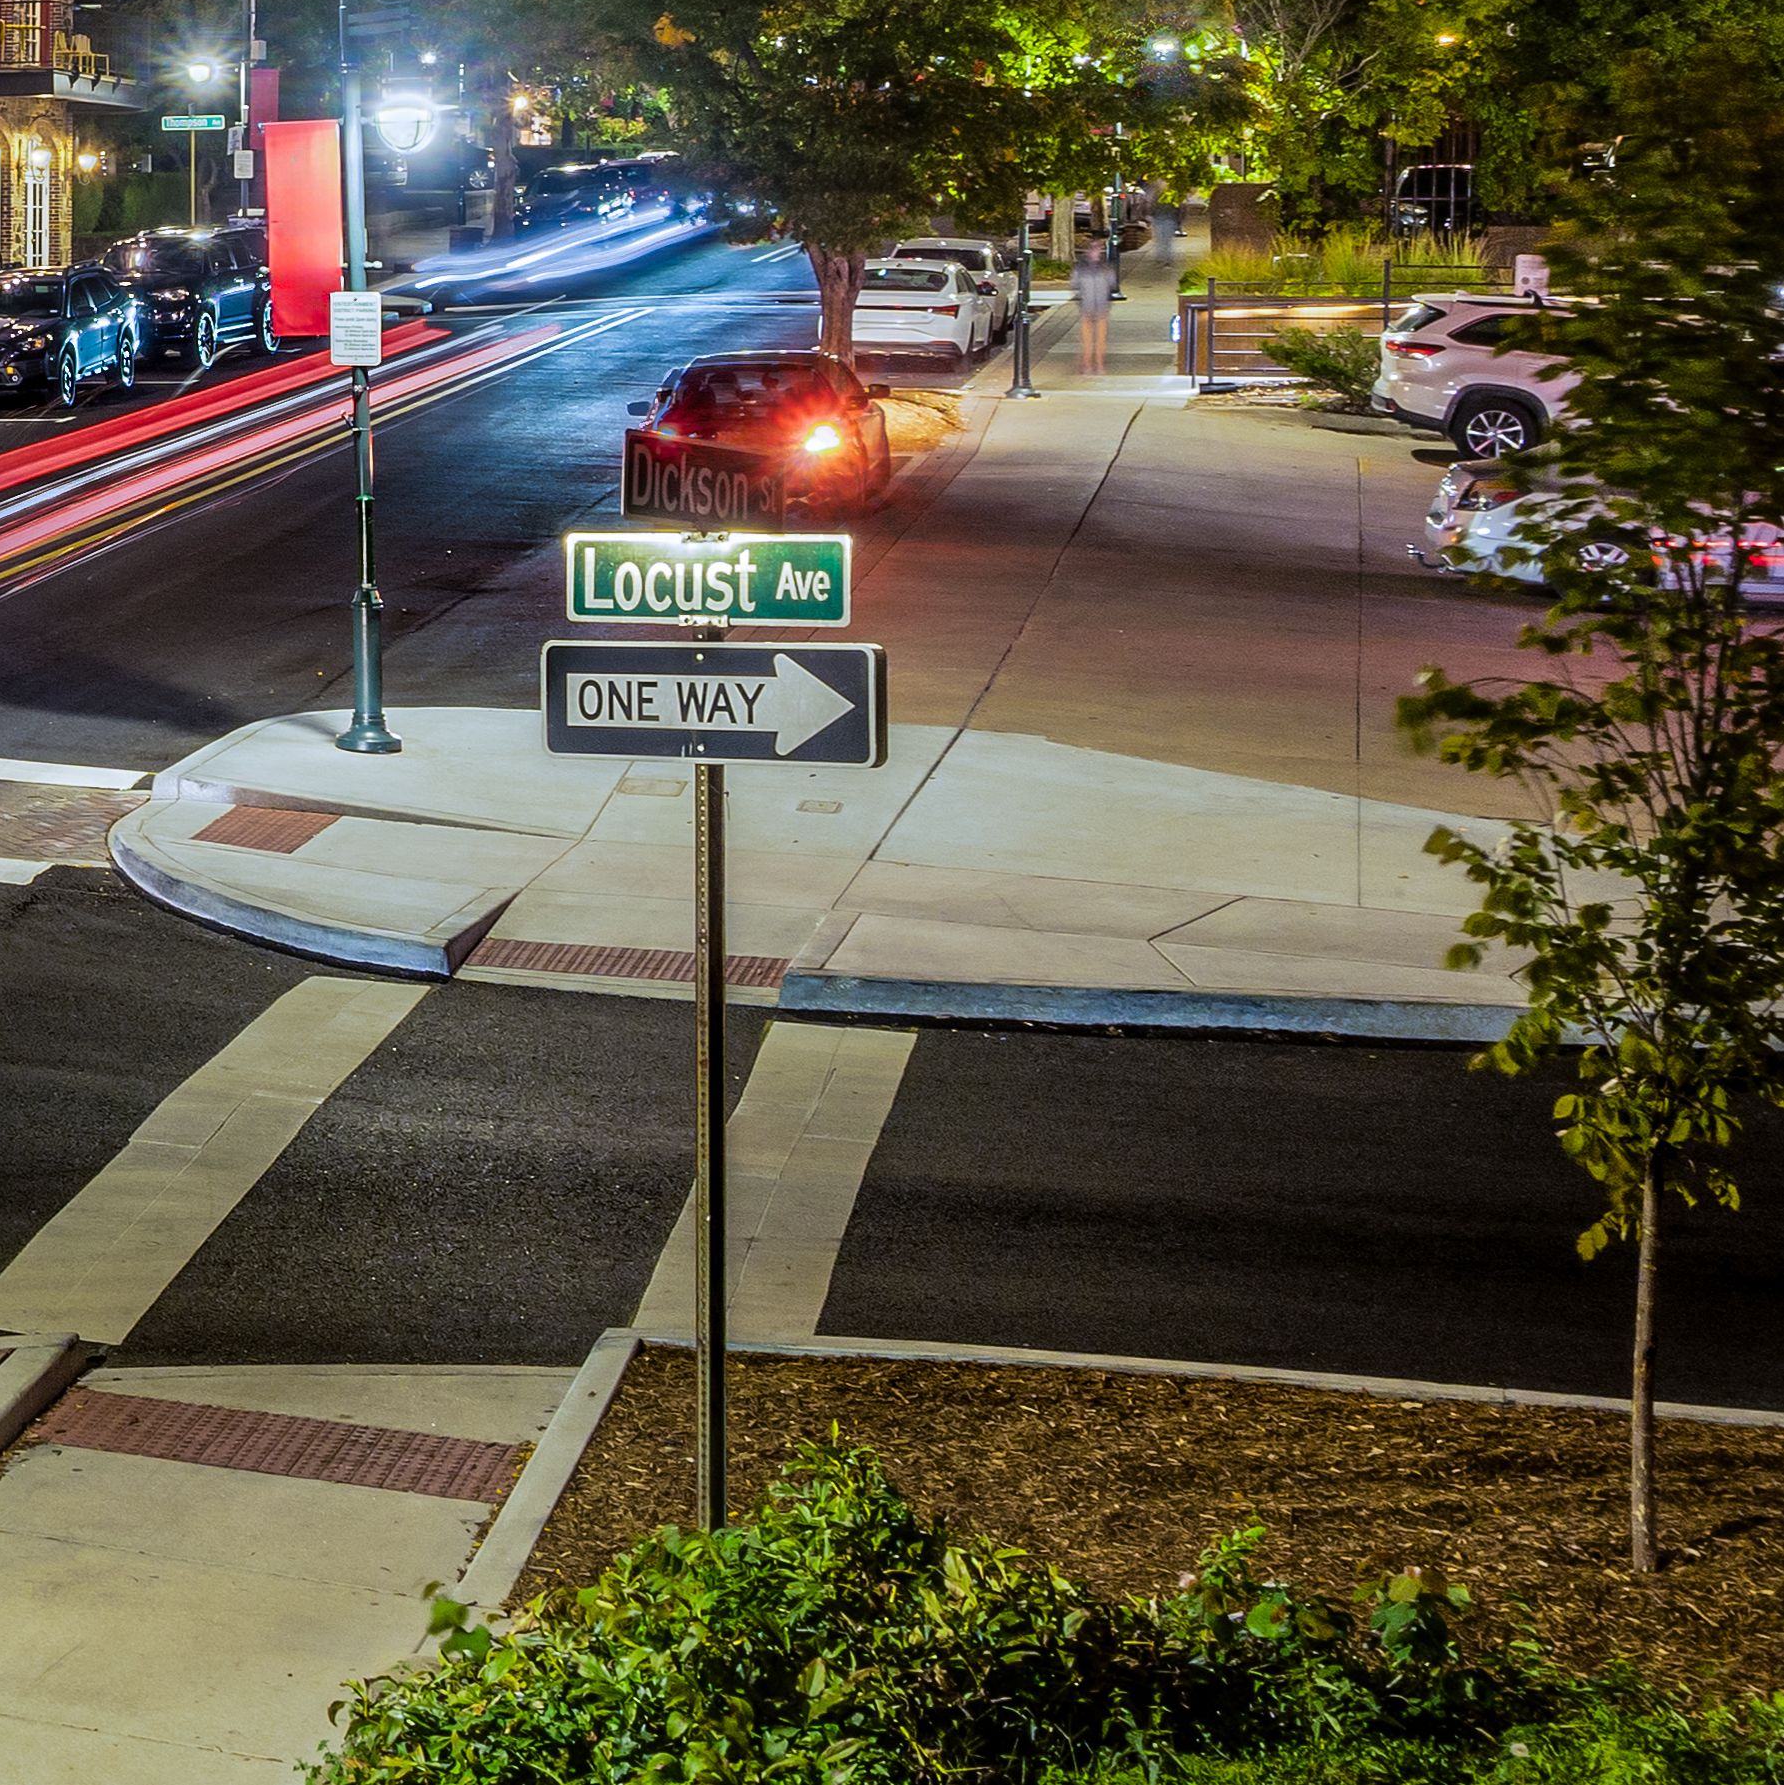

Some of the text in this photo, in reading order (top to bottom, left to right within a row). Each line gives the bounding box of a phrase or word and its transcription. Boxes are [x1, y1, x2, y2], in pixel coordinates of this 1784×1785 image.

[631, 443, 778, 519] Dickson St
[584, 547, 831, 612] Locust Ave
[578, 679, 765, 724] ONE WAY
